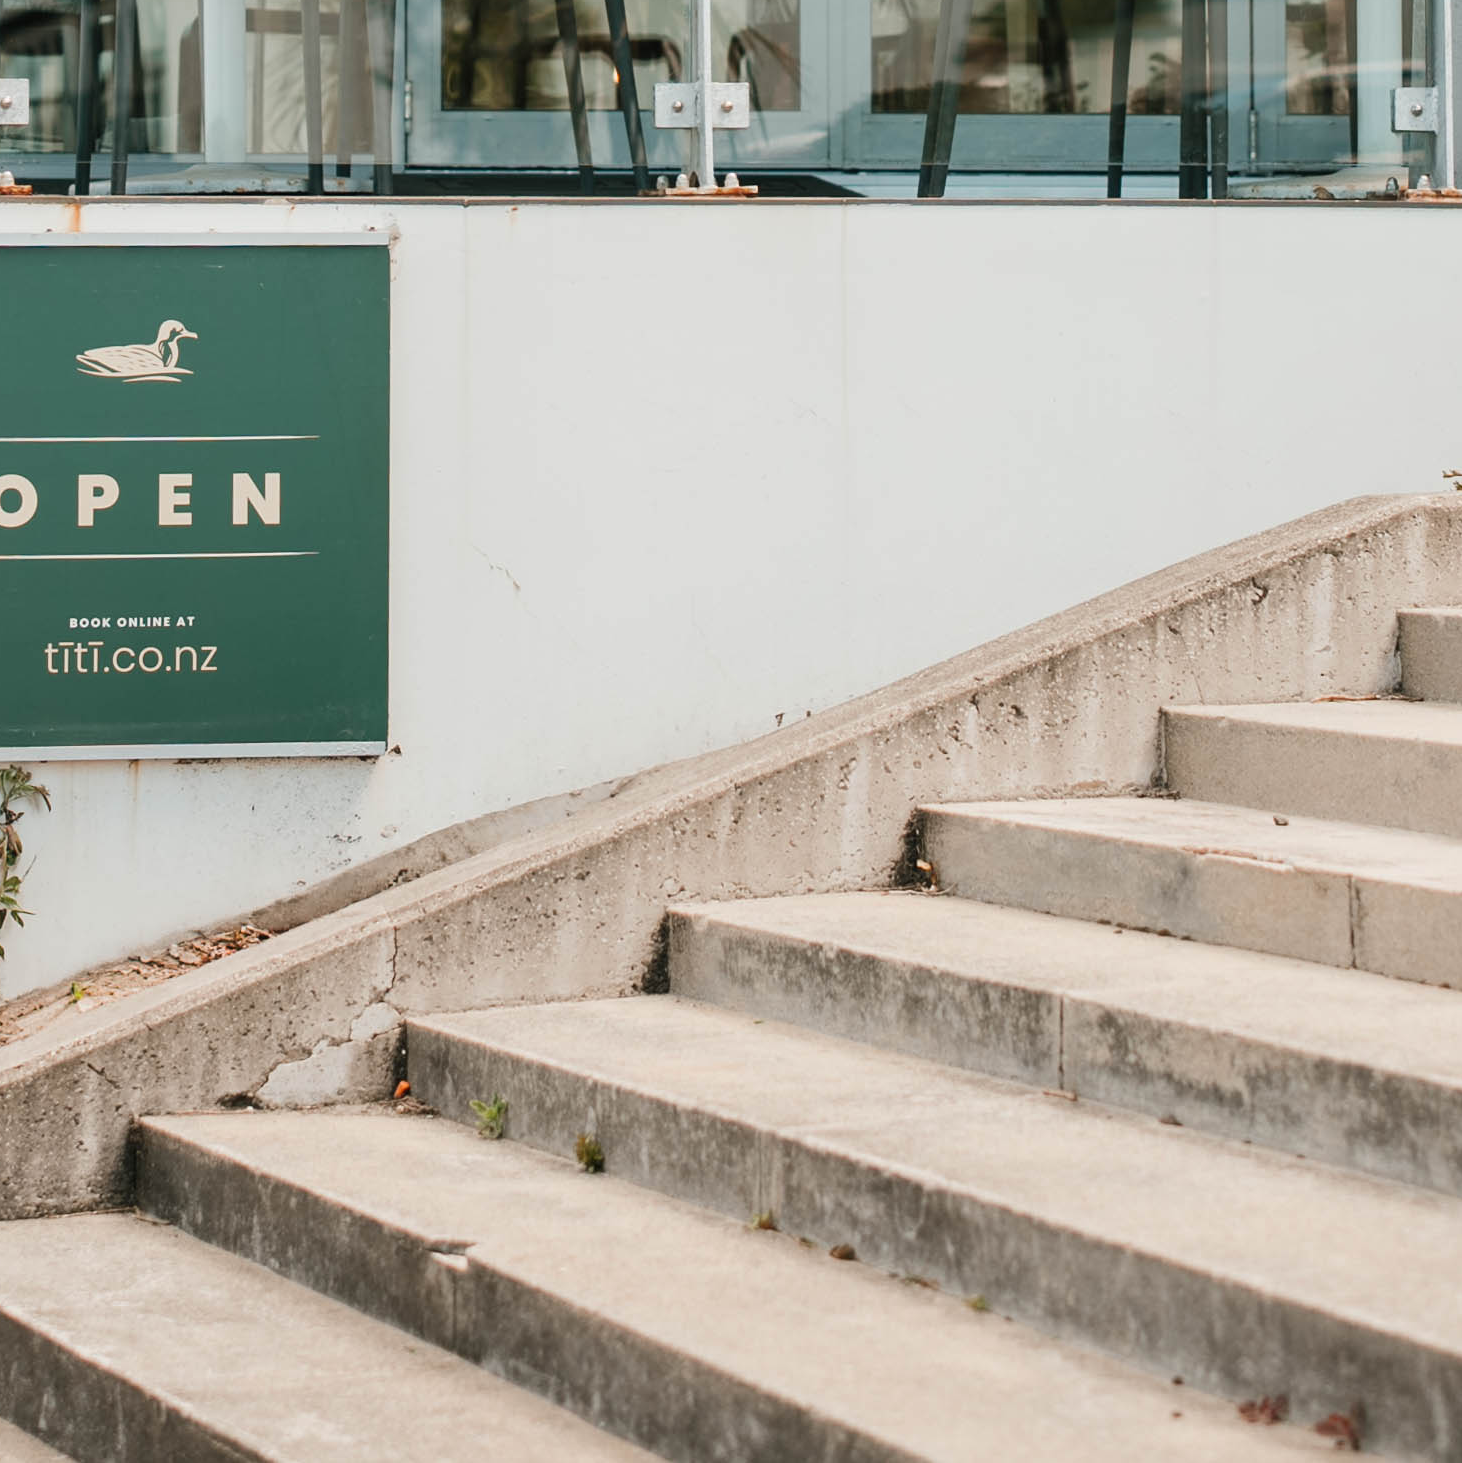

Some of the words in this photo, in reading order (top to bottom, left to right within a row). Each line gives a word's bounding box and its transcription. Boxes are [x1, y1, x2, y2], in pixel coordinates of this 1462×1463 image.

[68, 616, 112, 629] BOOK
[116, 616, 171, 628] ONLINE
[176, 615, 196, 627] AT
[44, 641, 218, 674] tītī.co.nz
